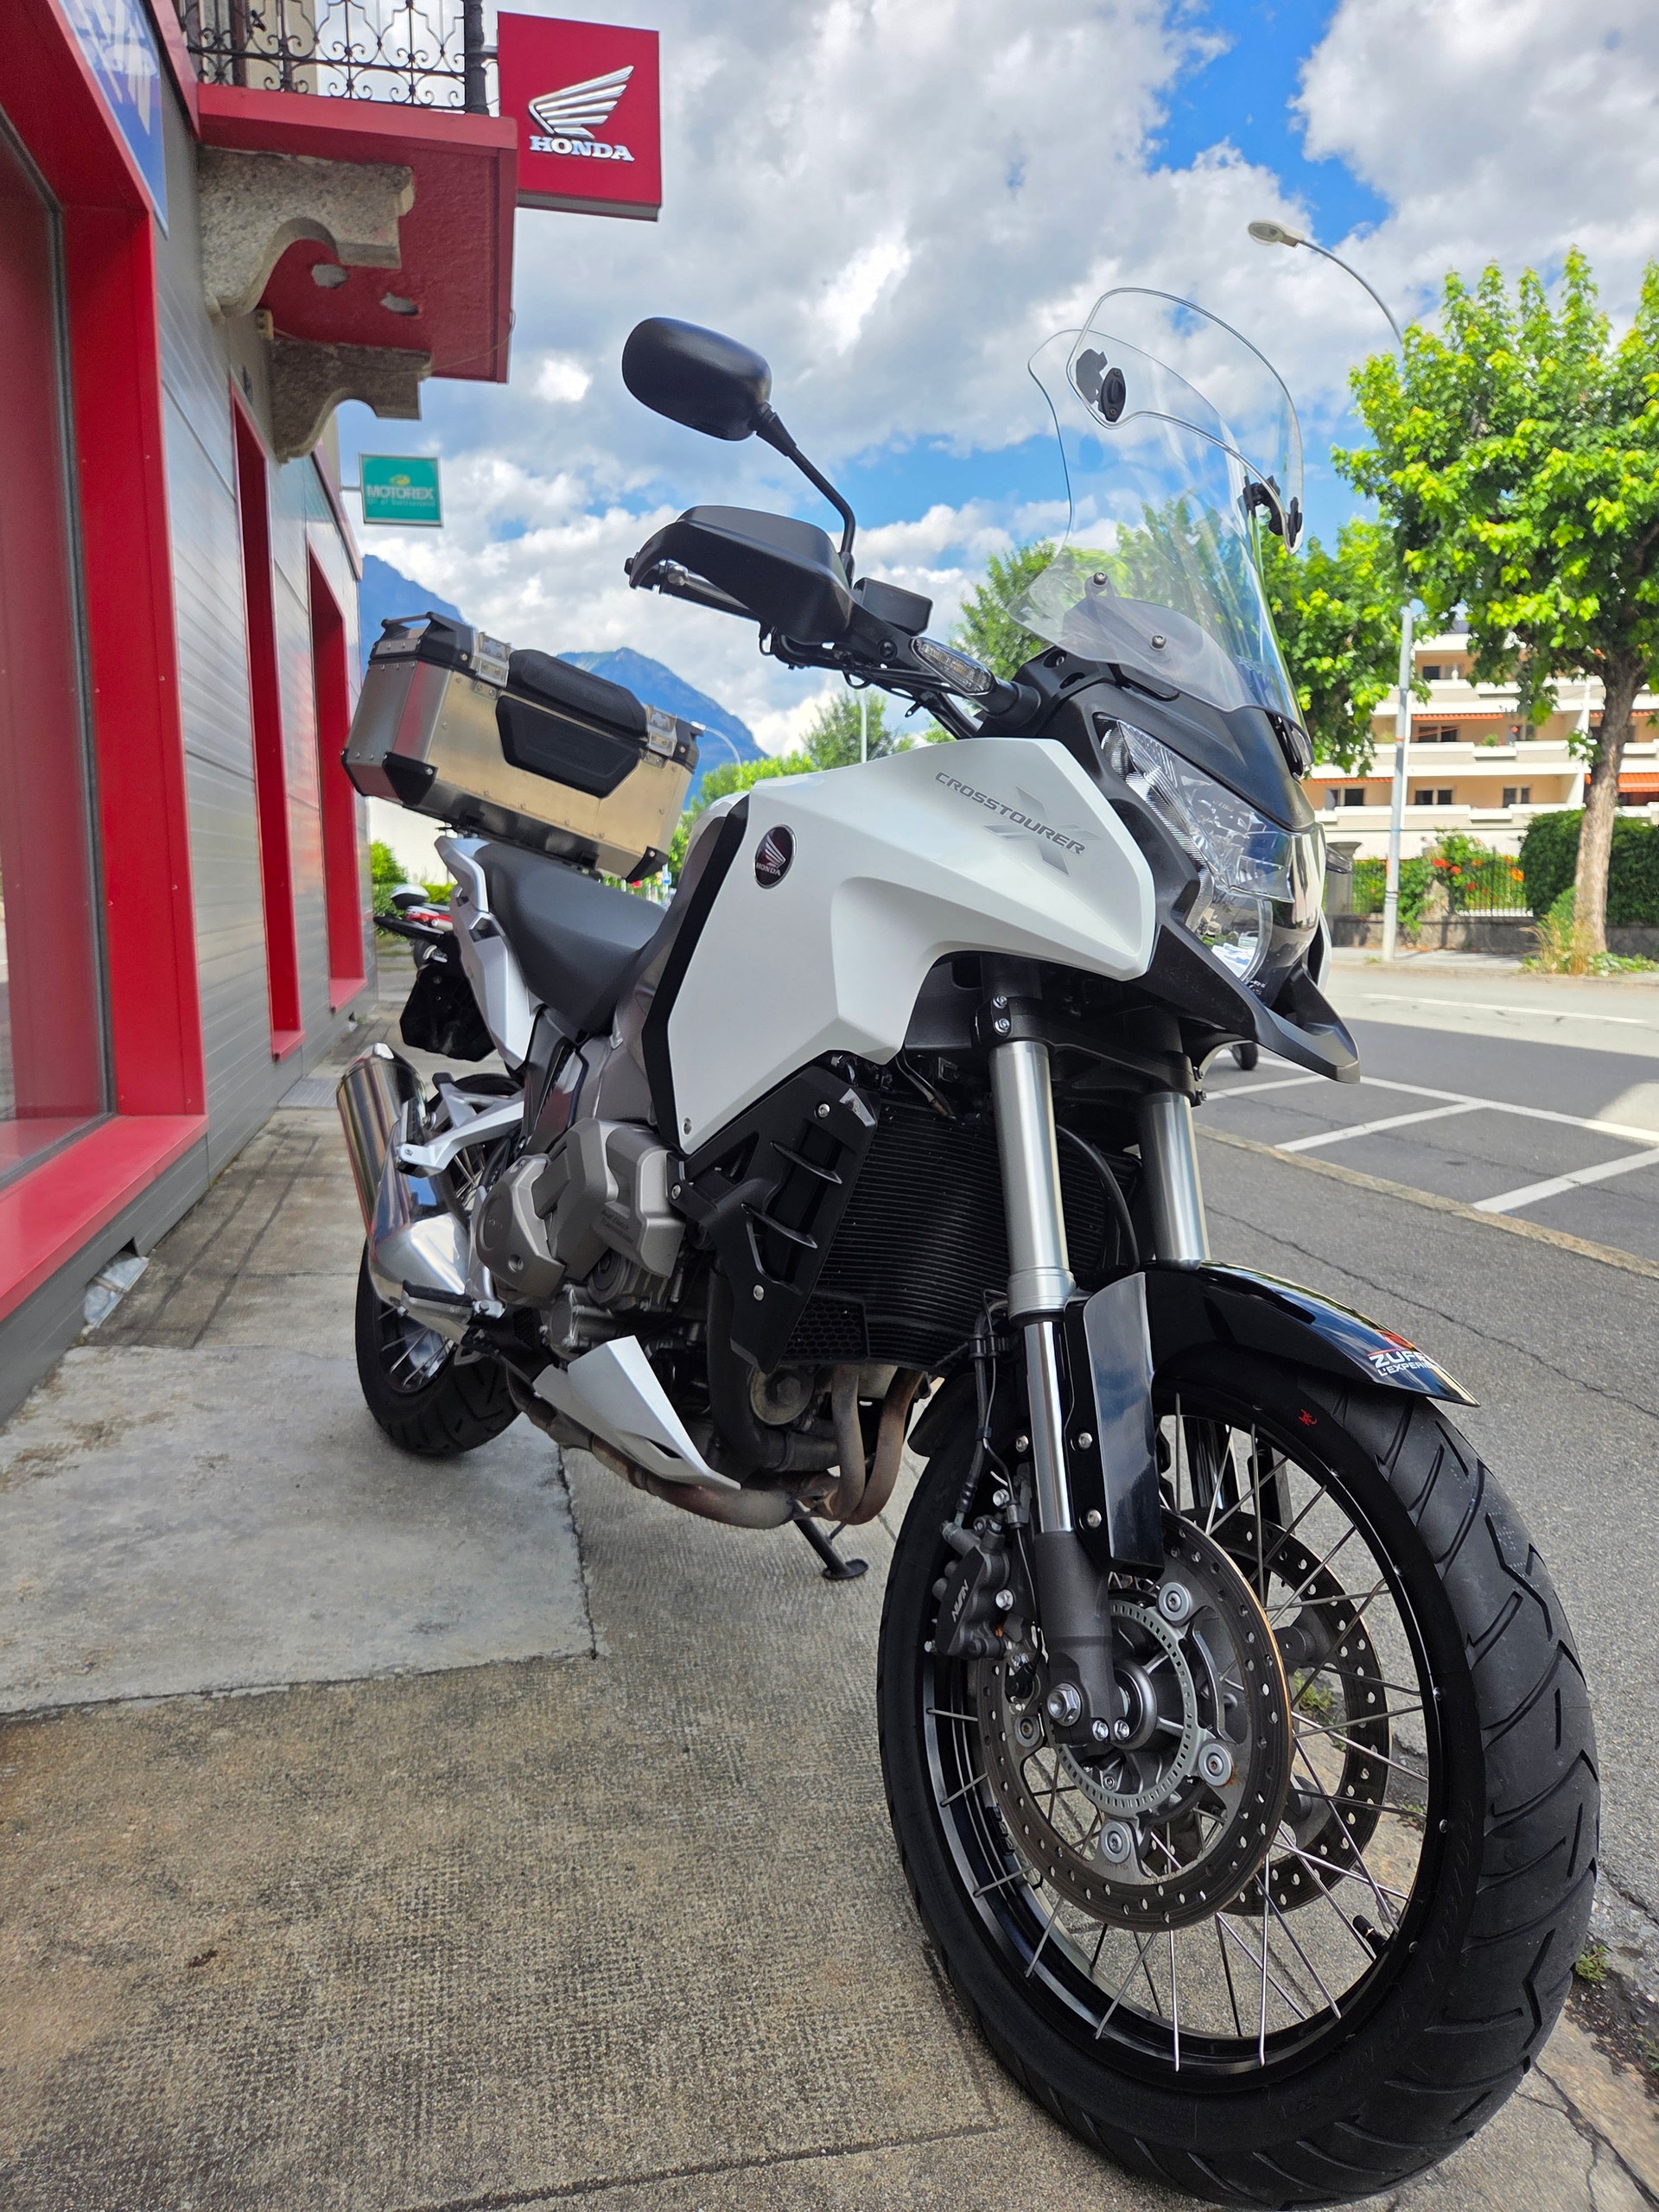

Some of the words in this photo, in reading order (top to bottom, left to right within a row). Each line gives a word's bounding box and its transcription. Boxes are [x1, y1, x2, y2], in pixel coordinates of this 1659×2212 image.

[529, 135, 635, 162] HONDA
[366, 484, 435, 500] MOTOREX
[935, 772, 1085, 855] CROSSTOURER
[755, 862, 781, 876] HONDA
